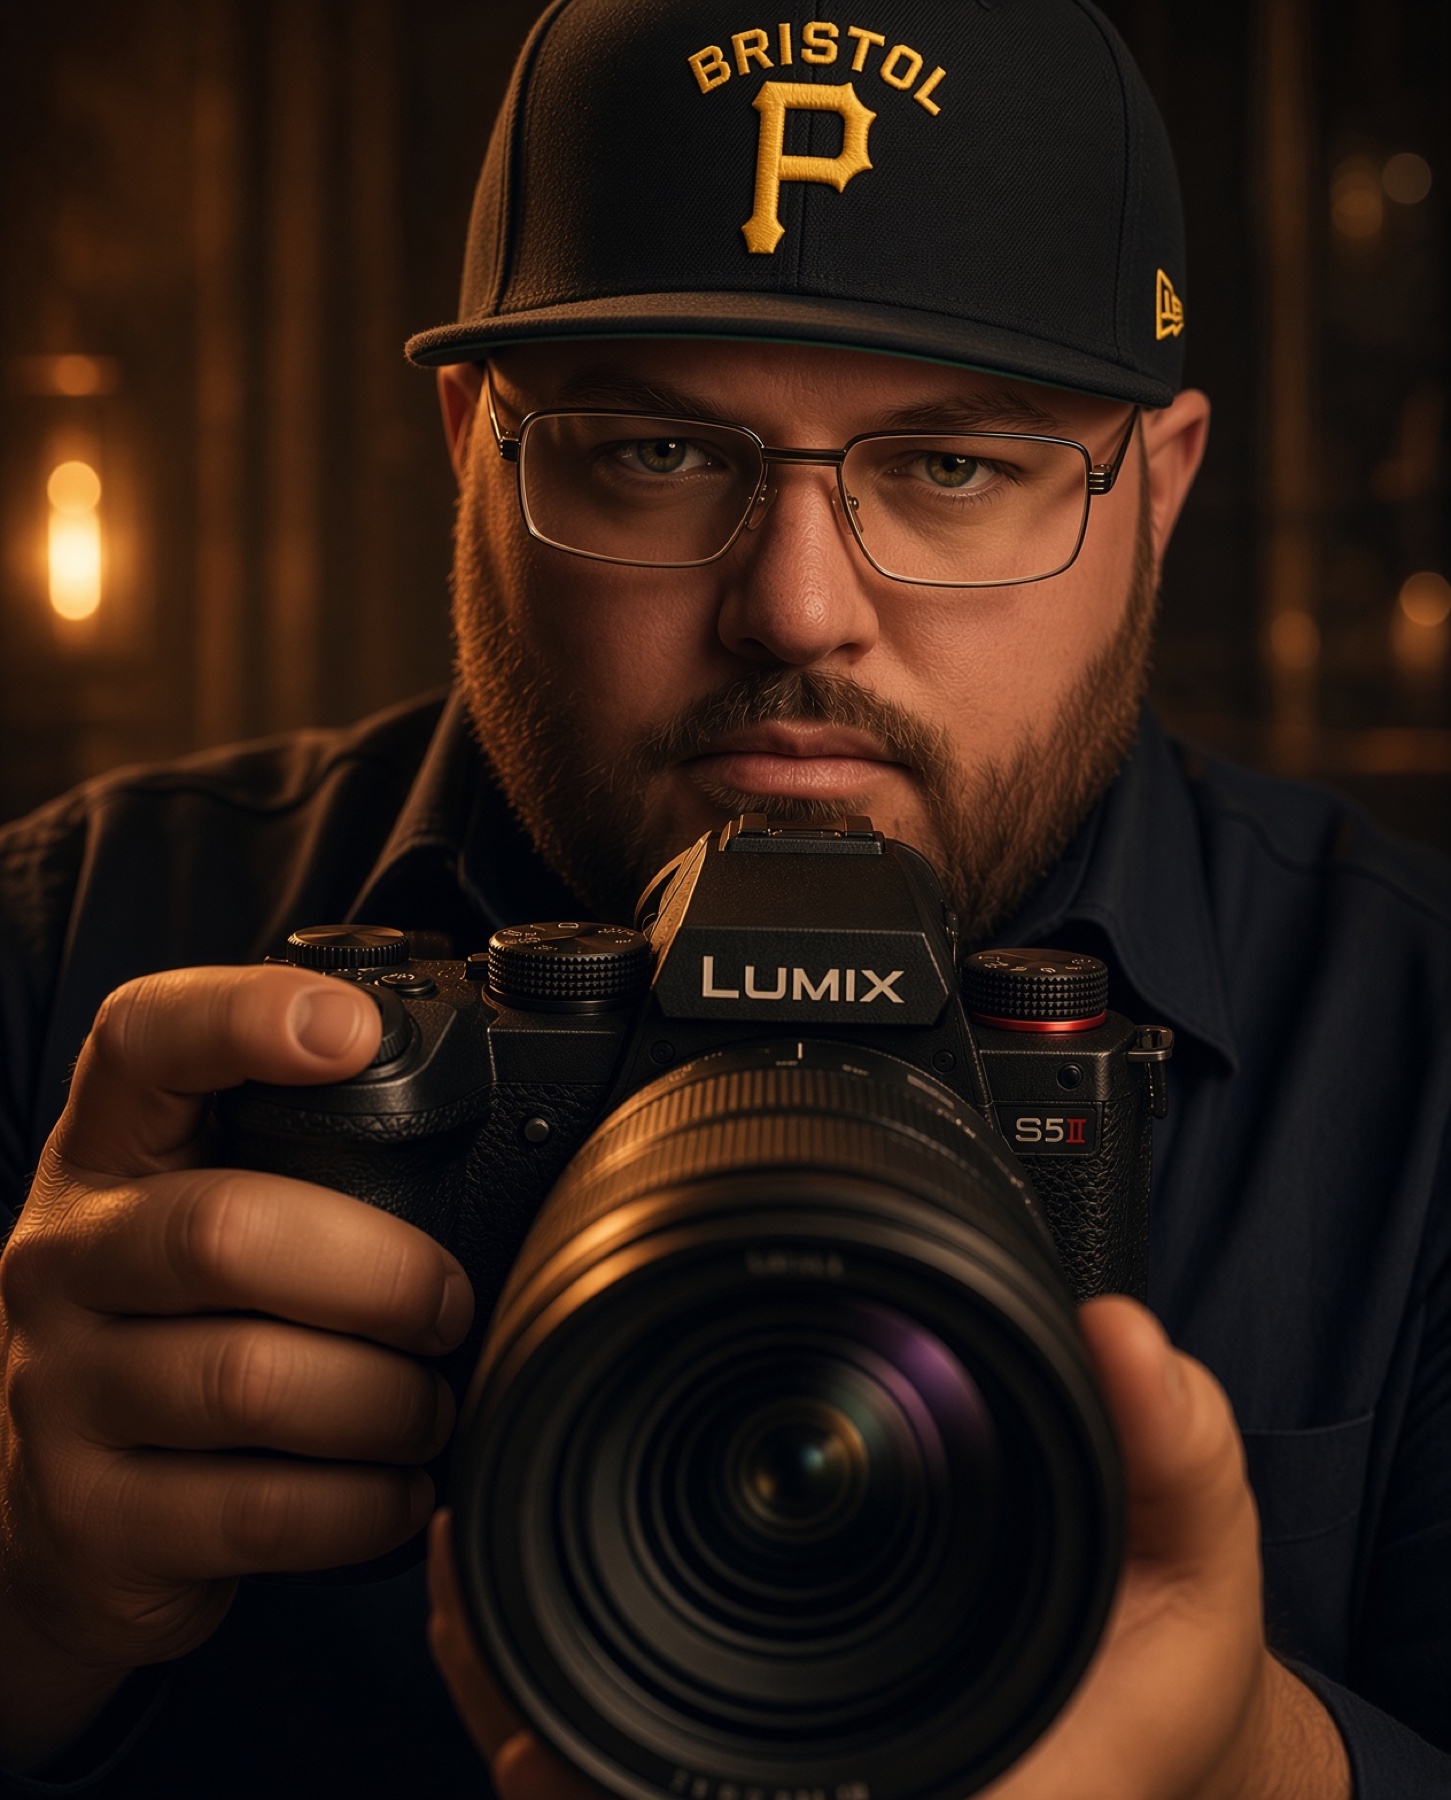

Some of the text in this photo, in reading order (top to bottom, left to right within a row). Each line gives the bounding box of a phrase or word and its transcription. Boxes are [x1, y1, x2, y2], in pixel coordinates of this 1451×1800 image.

[688, 21, 946, 116] BRISTOL
[741, 81, 877, 254] P
[702, 955, 905, 1004] LUMIX
